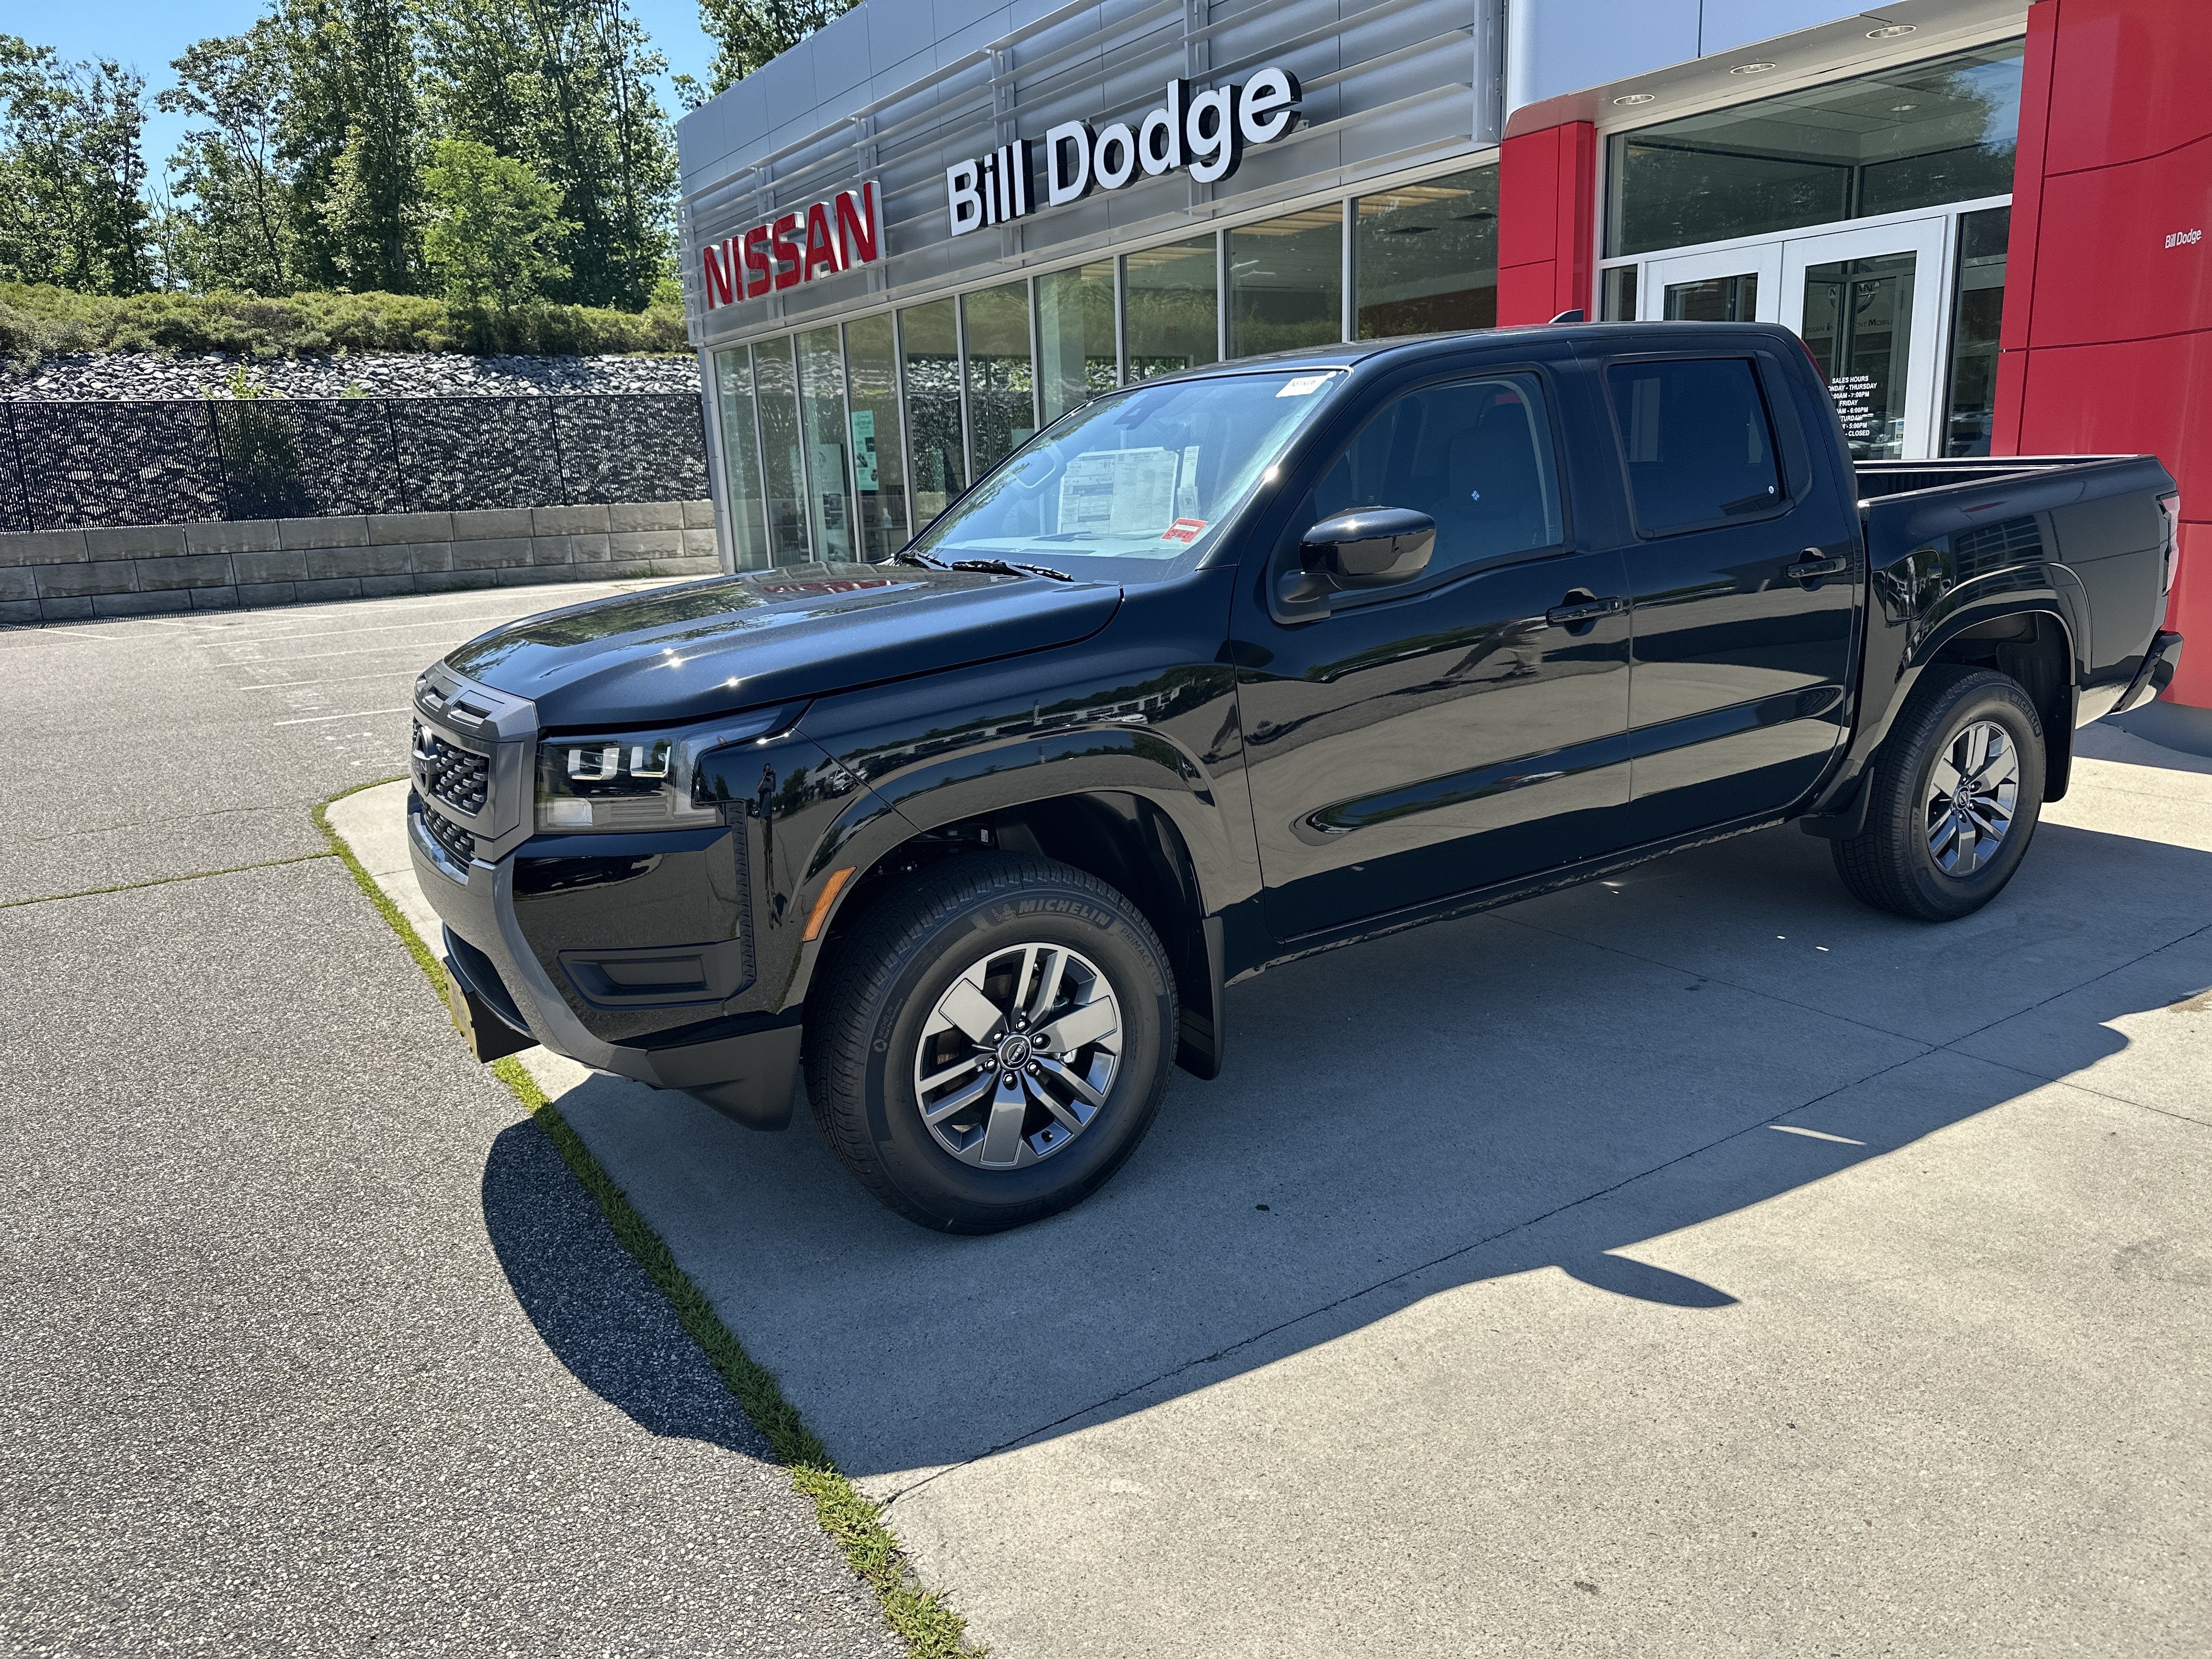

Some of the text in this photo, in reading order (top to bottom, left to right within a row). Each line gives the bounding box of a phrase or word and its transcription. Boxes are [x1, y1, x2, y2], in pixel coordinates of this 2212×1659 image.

[947, 67, 1296, 236] Bill Dodge
[704, 182, 881, 309] NISSAN
[2164, 228, 2202, 249] Bill Dodge
[2010, 693, 2041, 735] MICHELIN
[1018, 899, 1111, 926] MICHELIN
[1120, 927, 1155, 968] PRIMACY
[1152, 970, 1162, 986] LTX
[878, 1005, 894, 1037] MICHELIN
[887, 998, 904, 1028] Performance
[884, 1147, 895, 1155] 17
